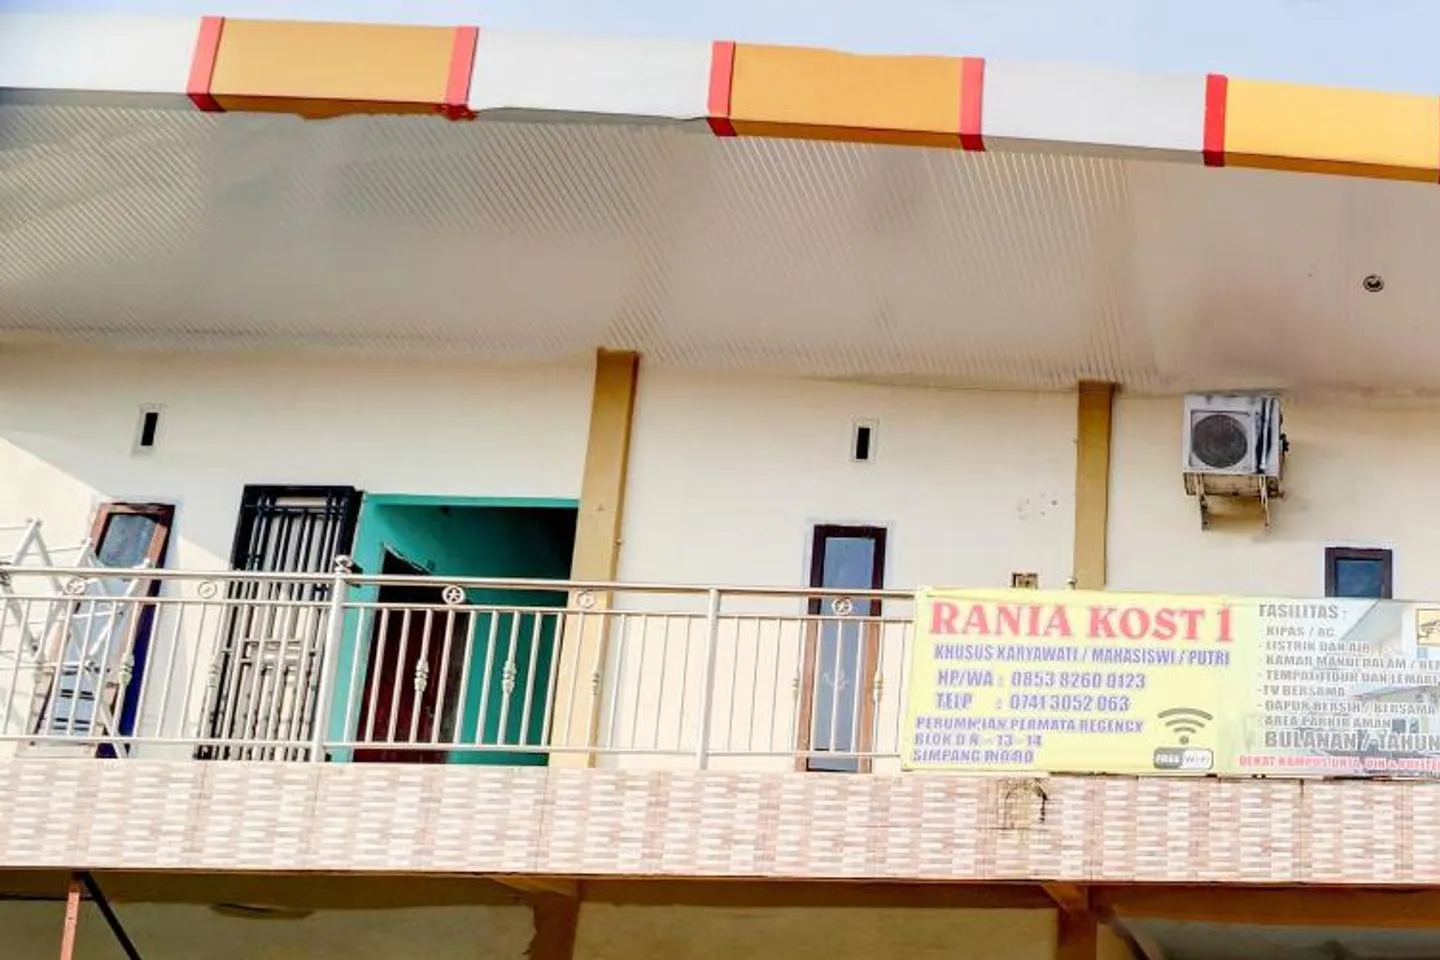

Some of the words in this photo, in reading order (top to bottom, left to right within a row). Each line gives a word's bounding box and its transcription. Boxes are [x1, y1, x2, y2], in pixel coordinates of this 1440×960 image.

[1259, 604, 1338, 619] FASILITAS
[929, 601, 1072, 637] RANIA
[1087, 607, 1205, 640] KOST
[1217, 605, 1233, 642] 1
[934, 644, 997, 661] KHUSUS
[999, 645, 1079, 663] KARYAWATI
[1092, 647, 1175, 665] MAHASISWI
[1189, 649, 1231, 667] PUTRI
[938, 670, 994, 687] HP/WA
[1011, 671, 1056, 688] 0853
[1059, 671, 1103, 689] 8260
[1106, 672, 1146, 690] 0123
[936, 693, 973, 710] TELP
[1010, 694, 1046, 711] 0741
[1050, 695, 1092, 712] 3052
[1011, 718, 1076, 732] PERMATA
[1079, 719, 1143, 733] REGENCY
[1265, 730, 1357, 748] BULANAN
[913, 750, 979, 762] SIMPANG
